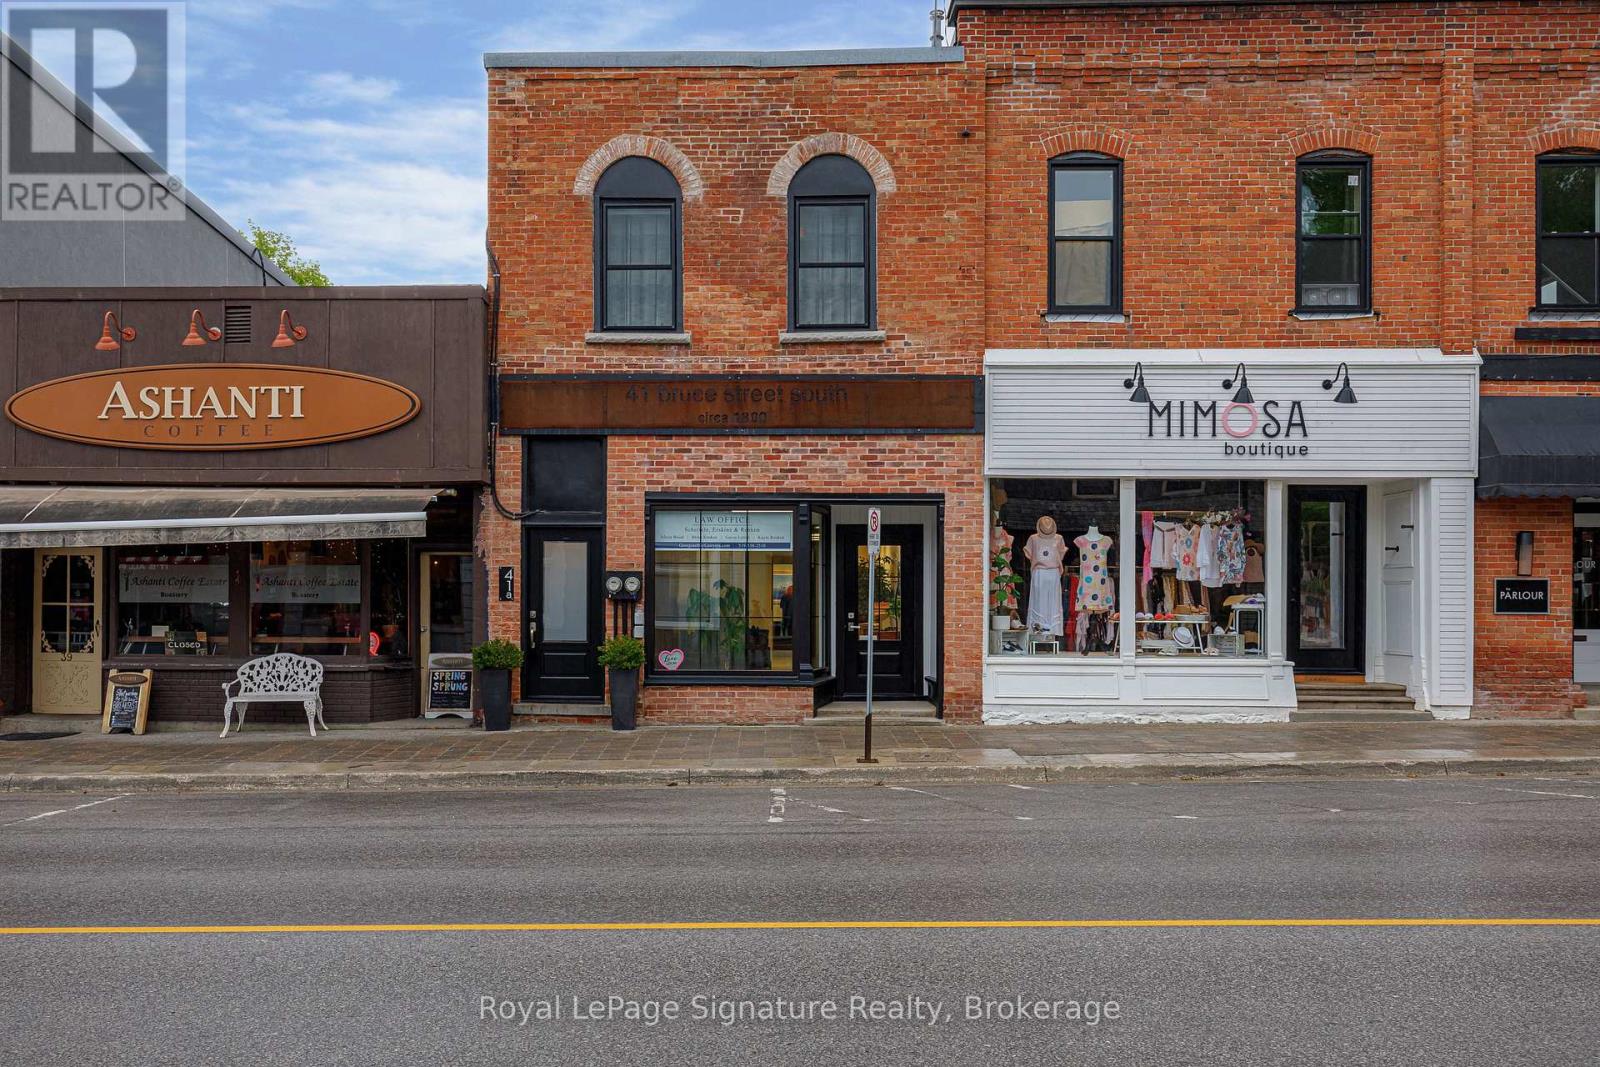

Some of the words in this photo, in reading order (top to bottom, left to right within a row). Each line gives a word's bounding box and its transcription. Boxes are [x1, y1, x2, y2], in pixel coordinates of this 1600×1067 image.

[723, 384, 784, 404] street
[789, 384, 849, 404] south
[1148, 400, 1309, 439] MIMOSA
[144, 424, 273, 438] COFFEE
[1224, 442, 1309, 458] boutique
[130, 576, 166, 587] Ashanti
[167, 576, 195, 590] Coffee
[1500, 591, 1544, 600] PARLOUR
[433, 672, 466, 681] SPRING
[432, 682, 469, 691] SPRUNG
